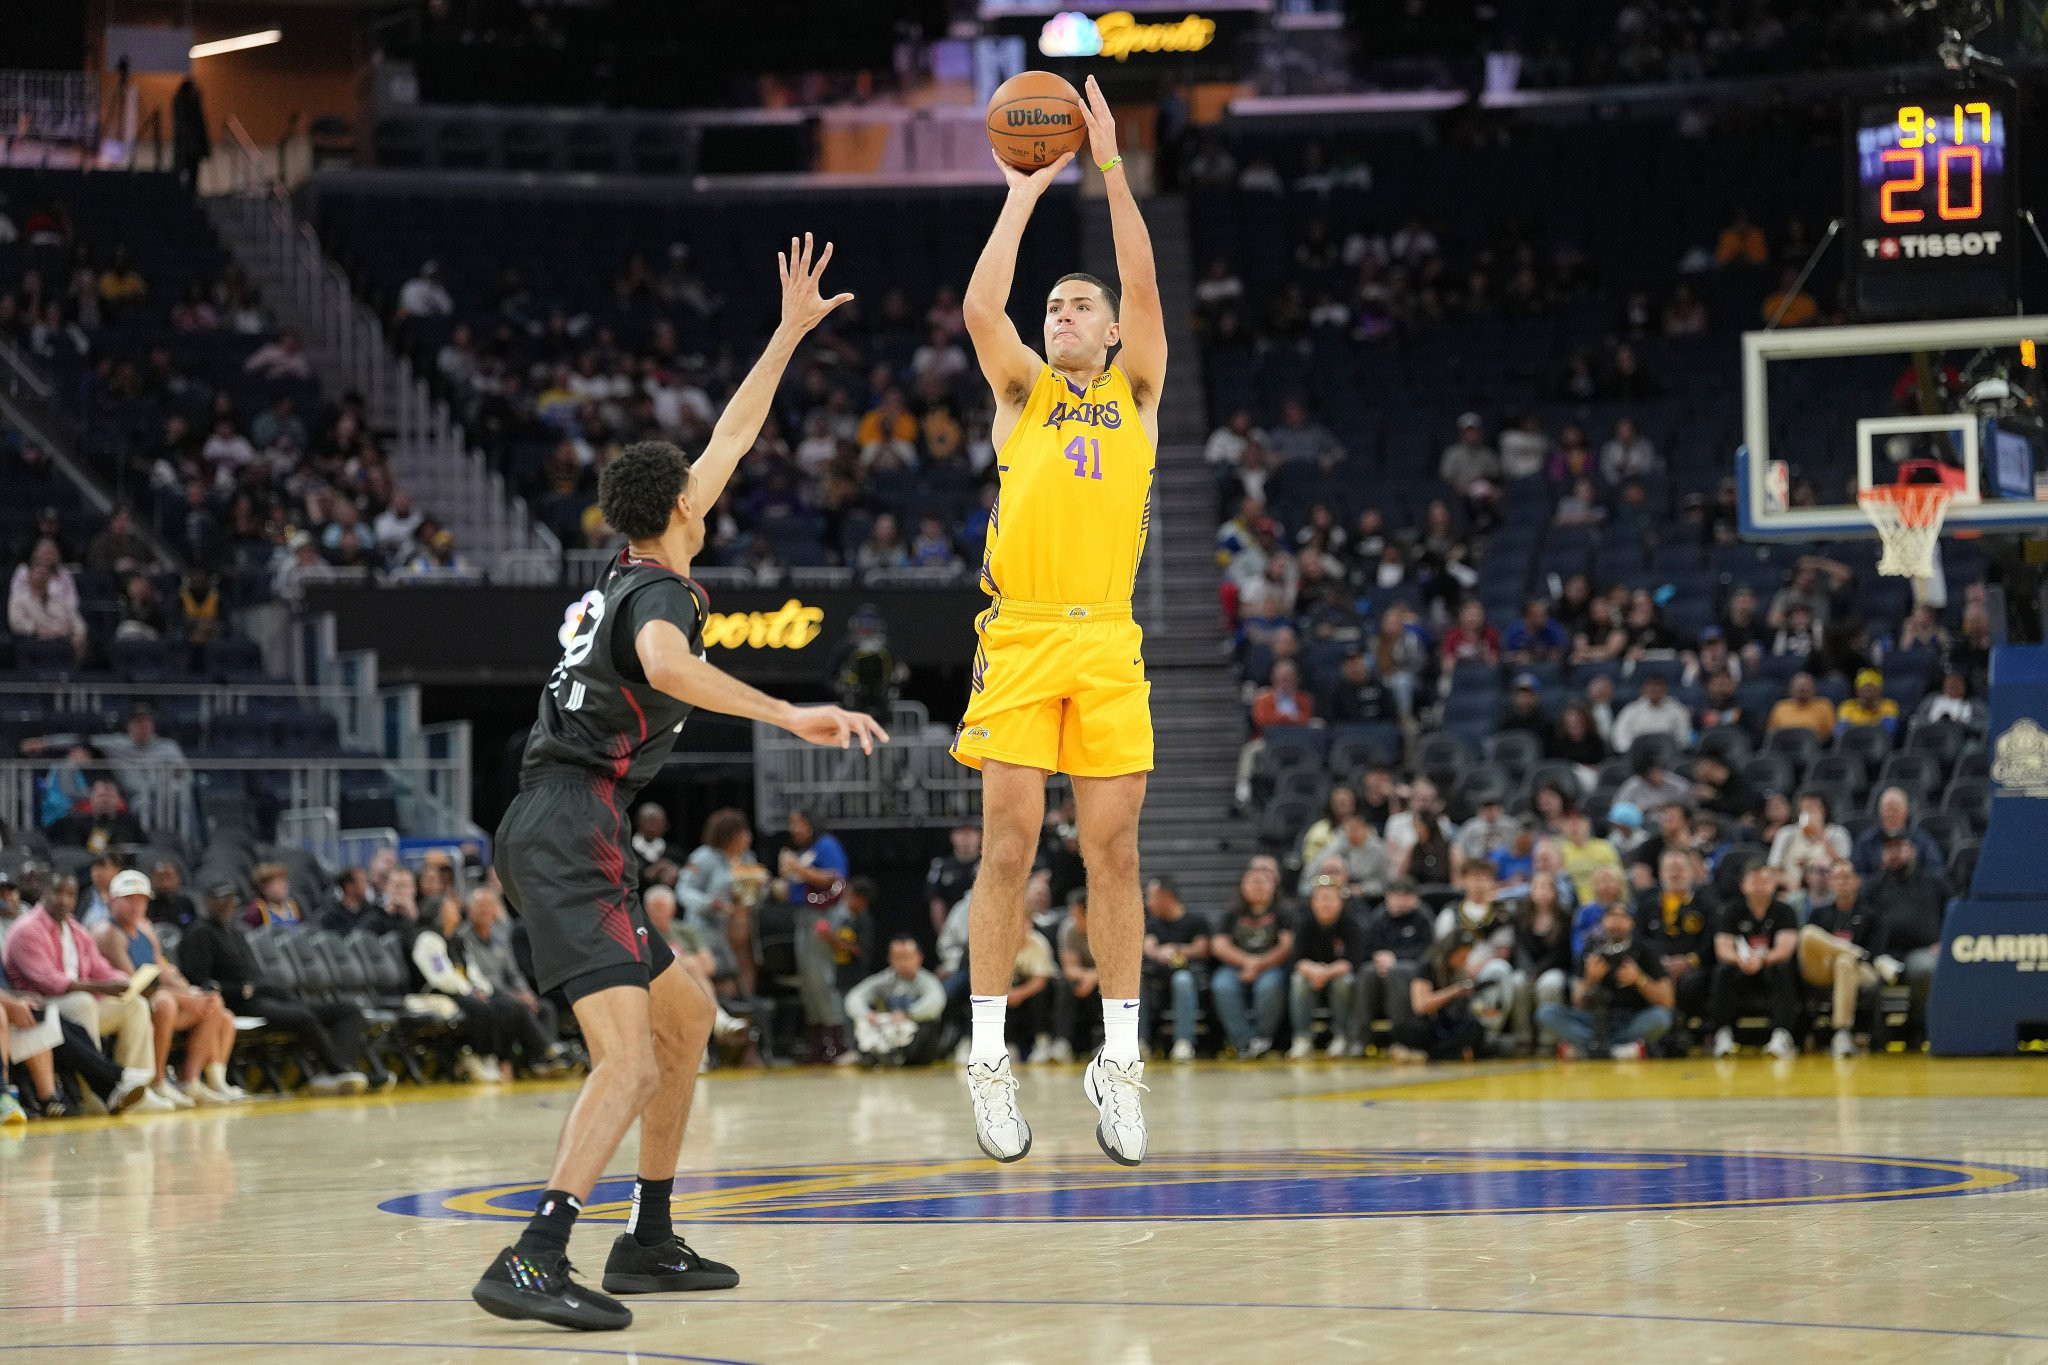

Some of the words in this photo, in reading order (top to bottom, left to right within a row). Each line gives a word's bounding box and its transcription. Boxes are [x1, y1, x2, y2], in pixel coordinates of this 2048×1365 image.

[1006, 107, 1072, 127] Wilson
[1898, 102, 1991, 149] 9:17
[1880, 145, 1982, 224] 20
[1900, 231, 2002, 258] TISSOT
[1063, 435, 1102, 480] 41
[701, 598, 824, 649] ports
